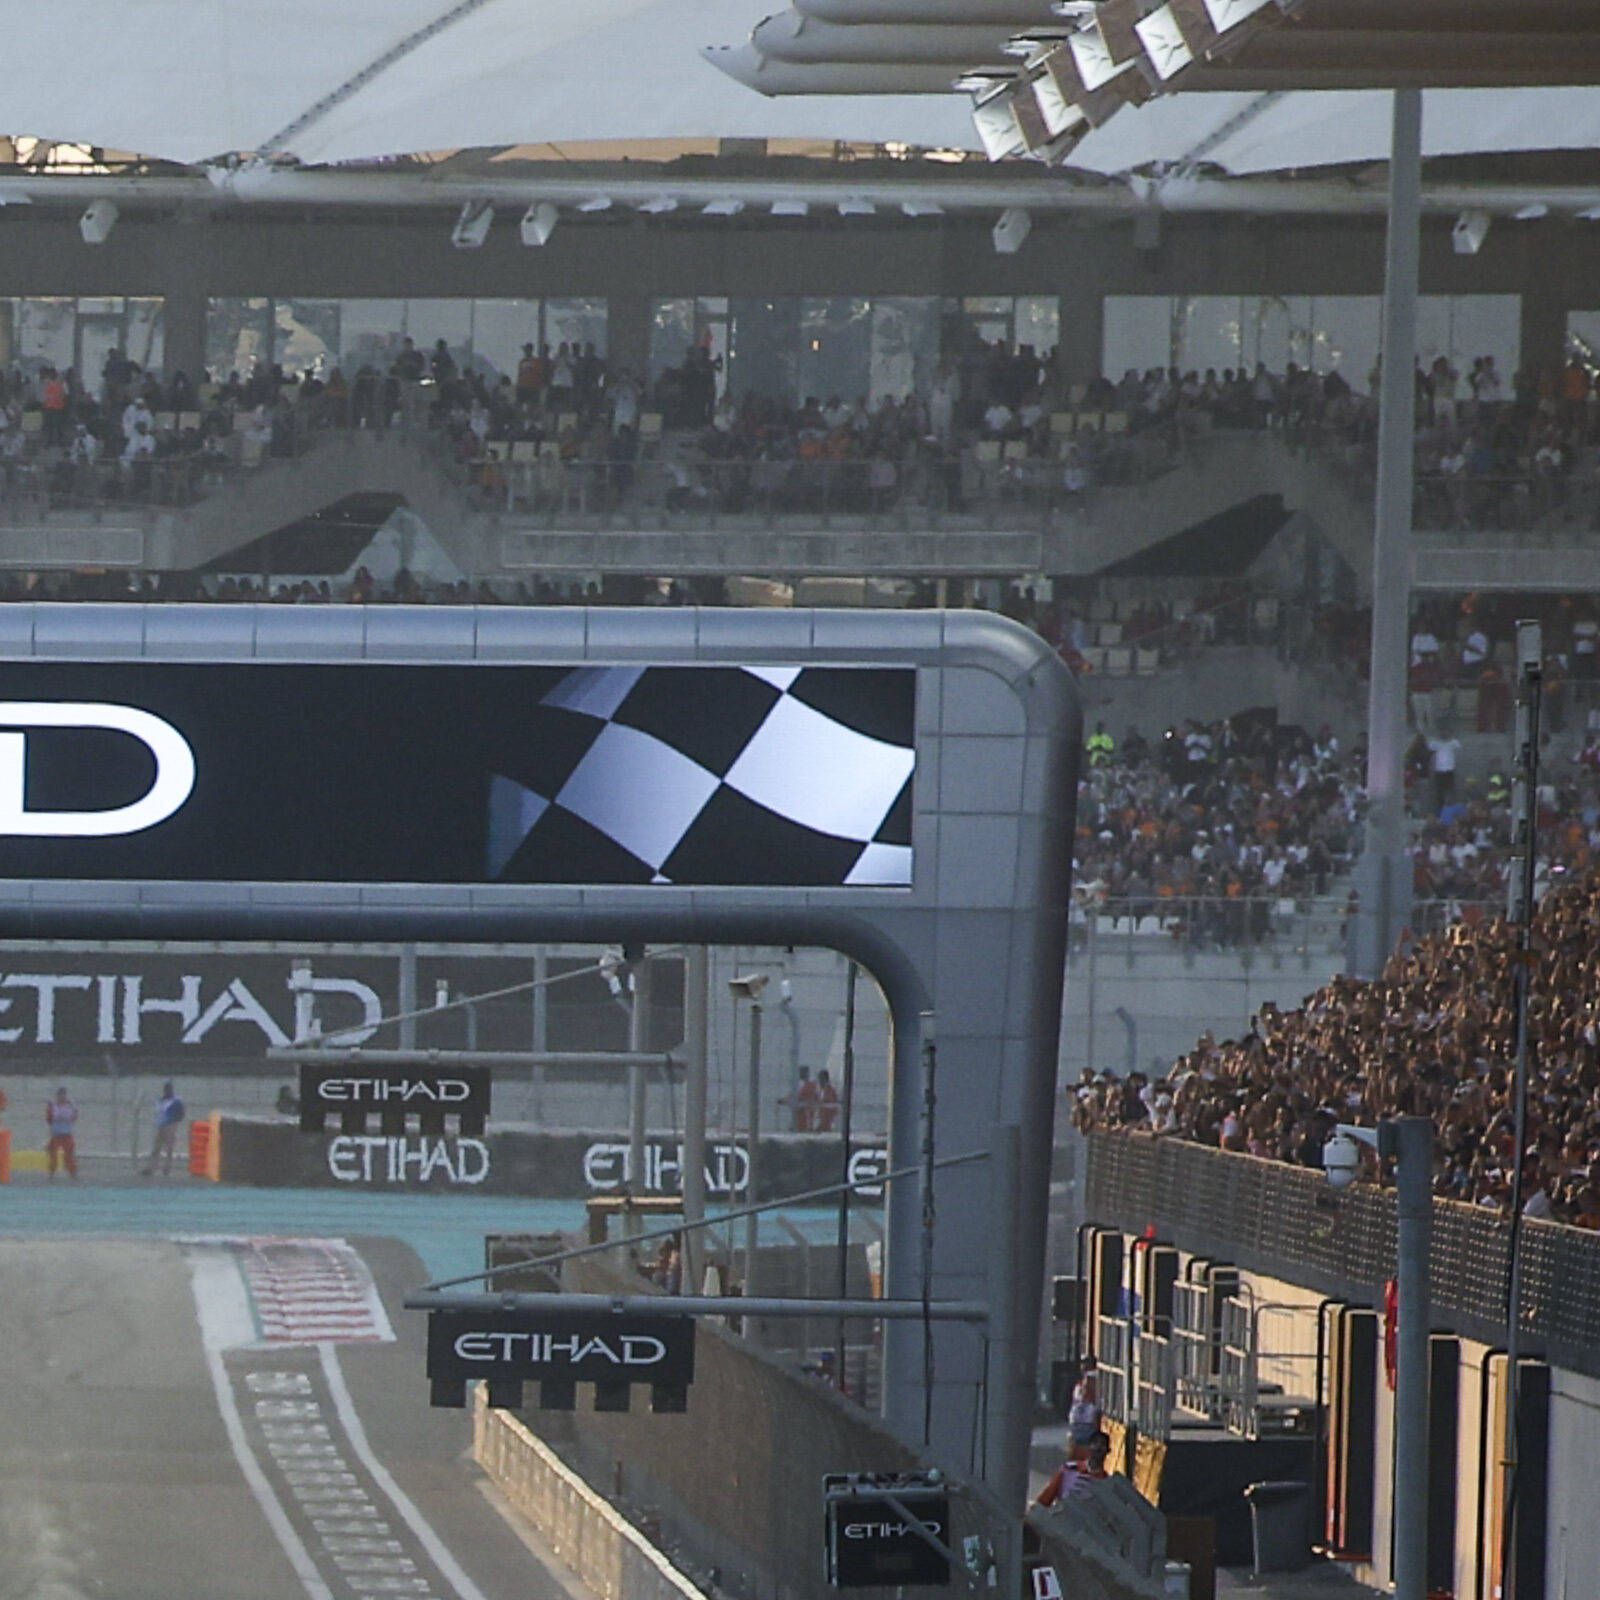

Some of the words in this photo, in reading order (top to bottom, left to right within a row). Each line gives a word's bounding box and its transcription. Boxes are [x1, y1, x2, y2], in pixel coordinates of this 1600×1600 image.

[318, 1079, 470, 1101] ETIHAD
[328, 1135, 489, 1184] ETIHAD
[454, 1332, 666, 1364] ETIHAD
